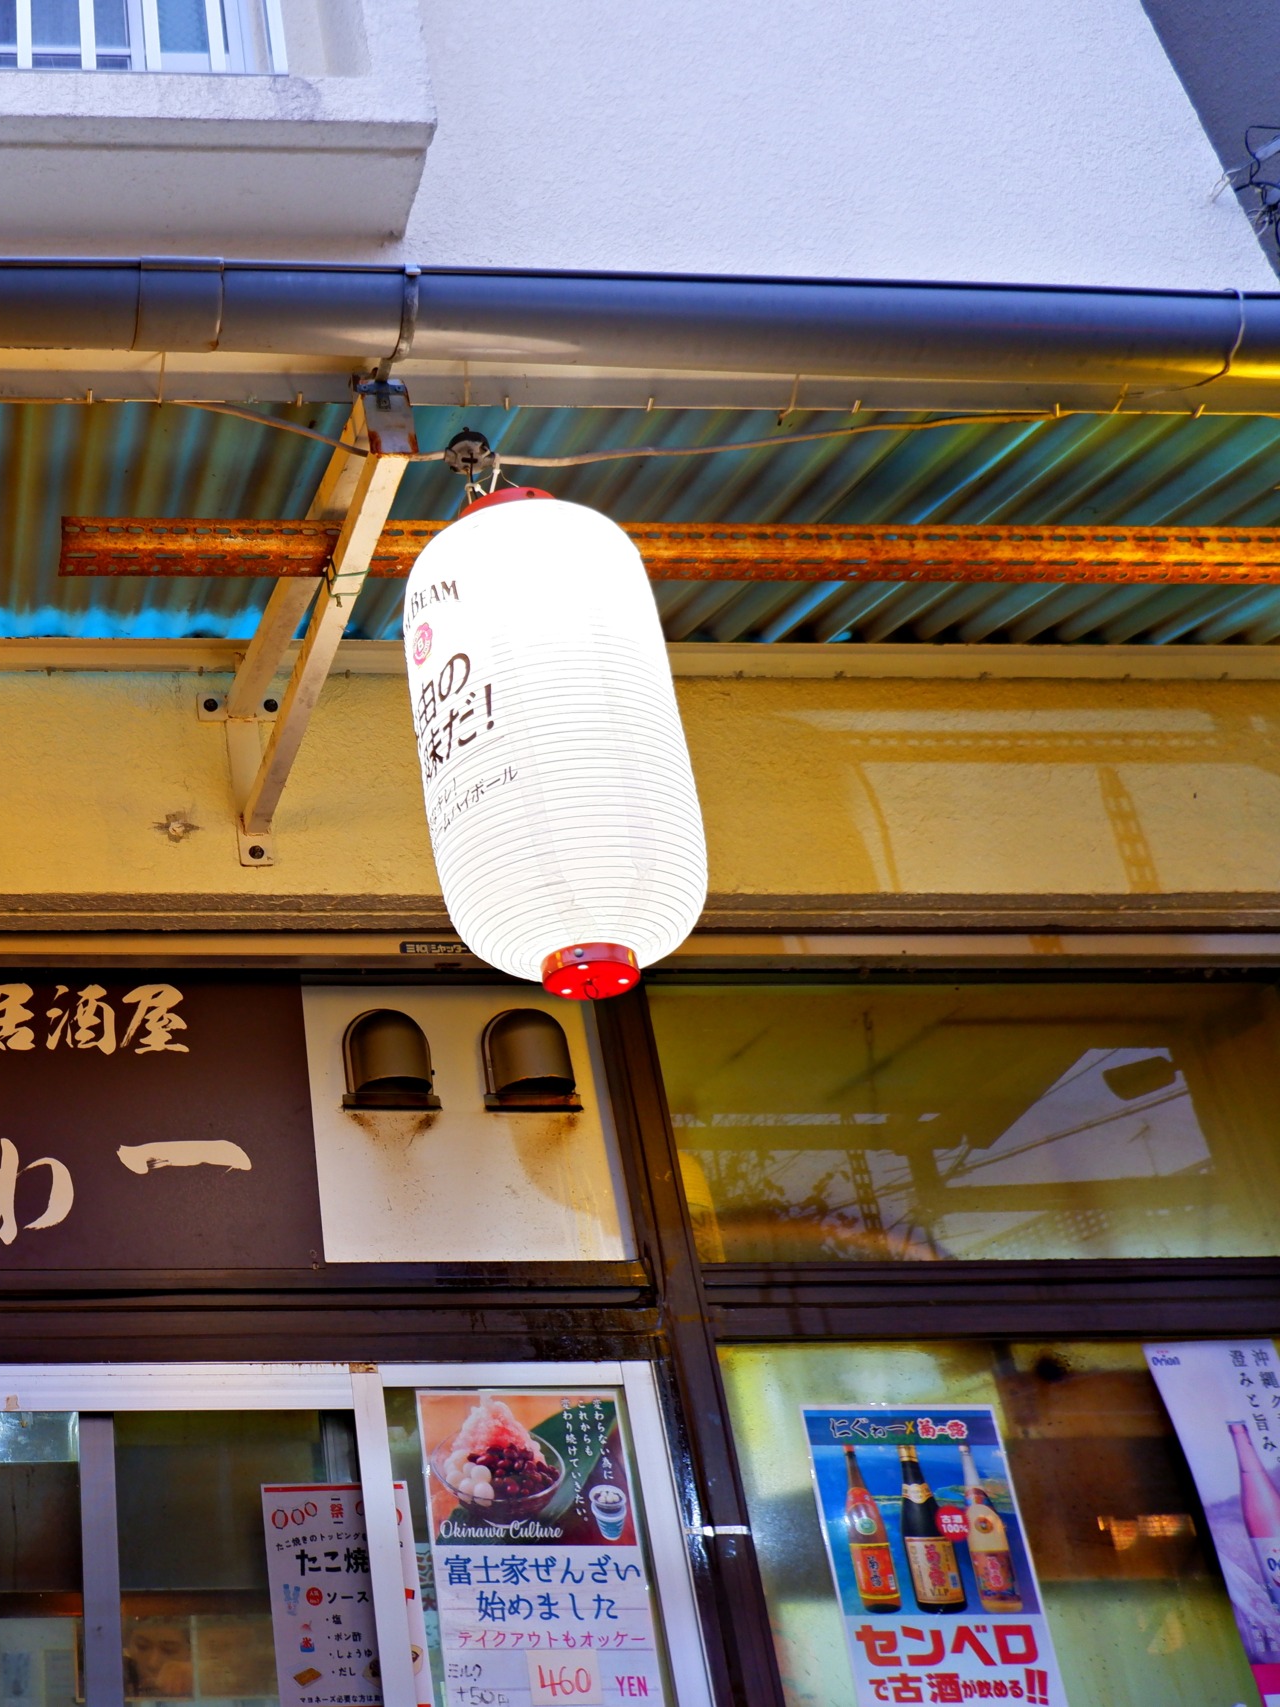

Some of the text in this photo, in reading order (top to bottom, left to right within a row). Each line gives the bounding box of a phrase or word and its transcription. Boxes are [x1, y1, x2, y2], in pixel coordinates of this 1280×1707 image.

[411, 580, 460, 620] BEAM
[577, 1400, 593, 1457] これからも
[440, 1520, 563, 1540] Okinawa Culture
[444, 1554, 642, 1586] 富士家ぜんざい
[327, 1591, 370, 1604] ソース
[476, 1590, 620, 1622] 始めました
[458, 1630, 647, 1649] テイクアウトもオッケー
[854, 1624, 1039, 1667] センベロ
[537, 1664, 648, 1697] 460 YEN
